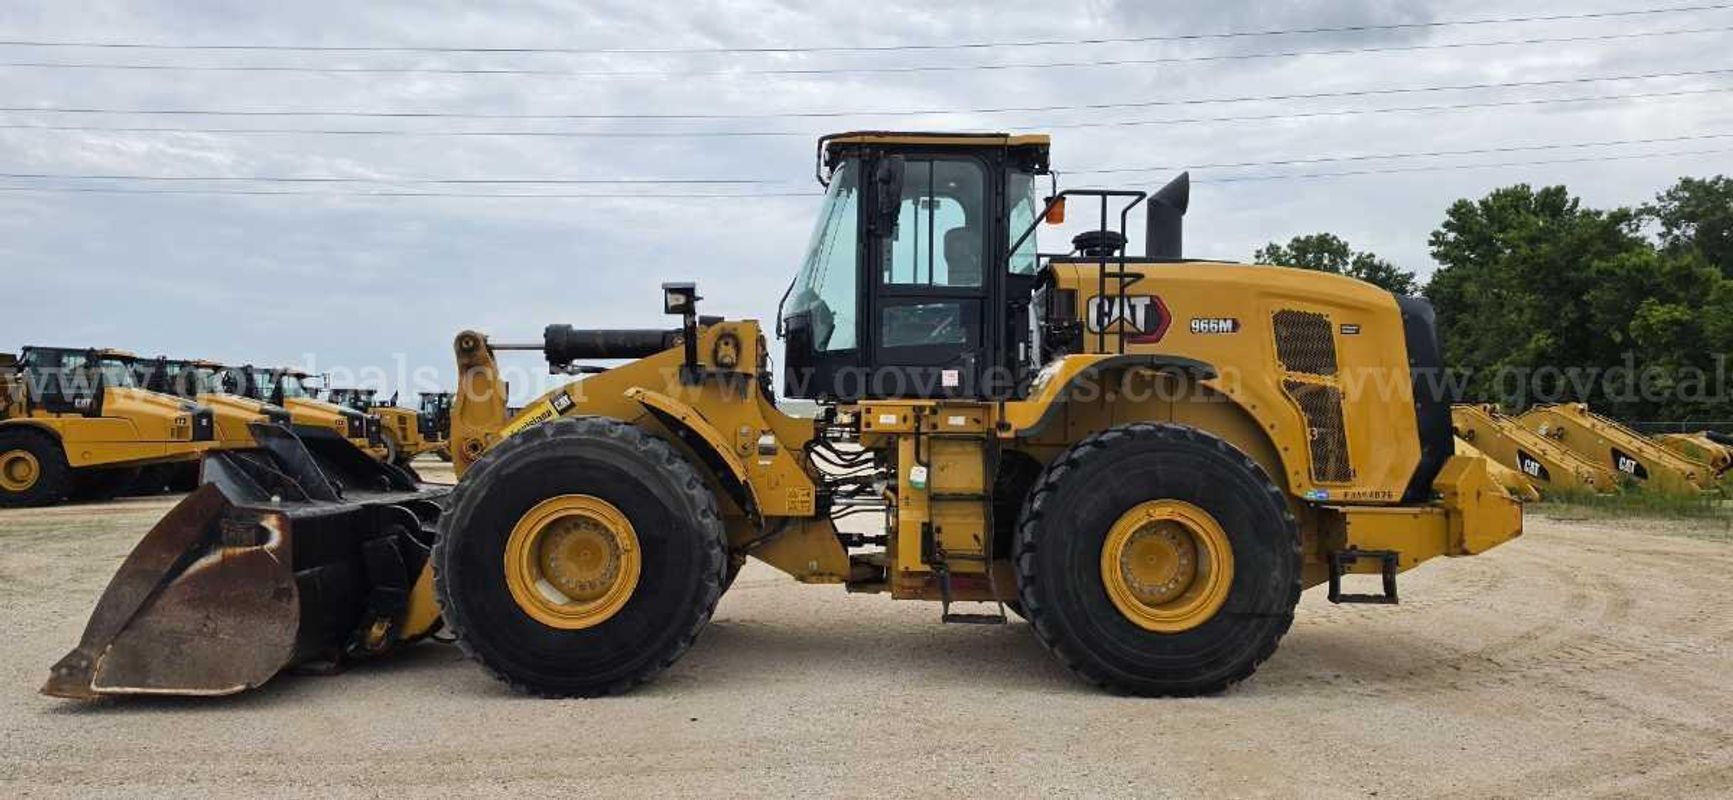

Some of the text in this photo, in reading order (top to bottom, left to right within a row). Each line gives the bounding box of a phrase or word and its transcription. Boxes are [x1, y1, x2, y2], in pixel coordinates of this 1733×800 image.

[1088, 296, 1152, 334] CAT
[1191, 319, 1234, 334] 966M
[510, 394, 571, 436] uisiana CAT
[1523, 458, 1541, 477] CAT
[1619, 456, 1638, 474] CAT
